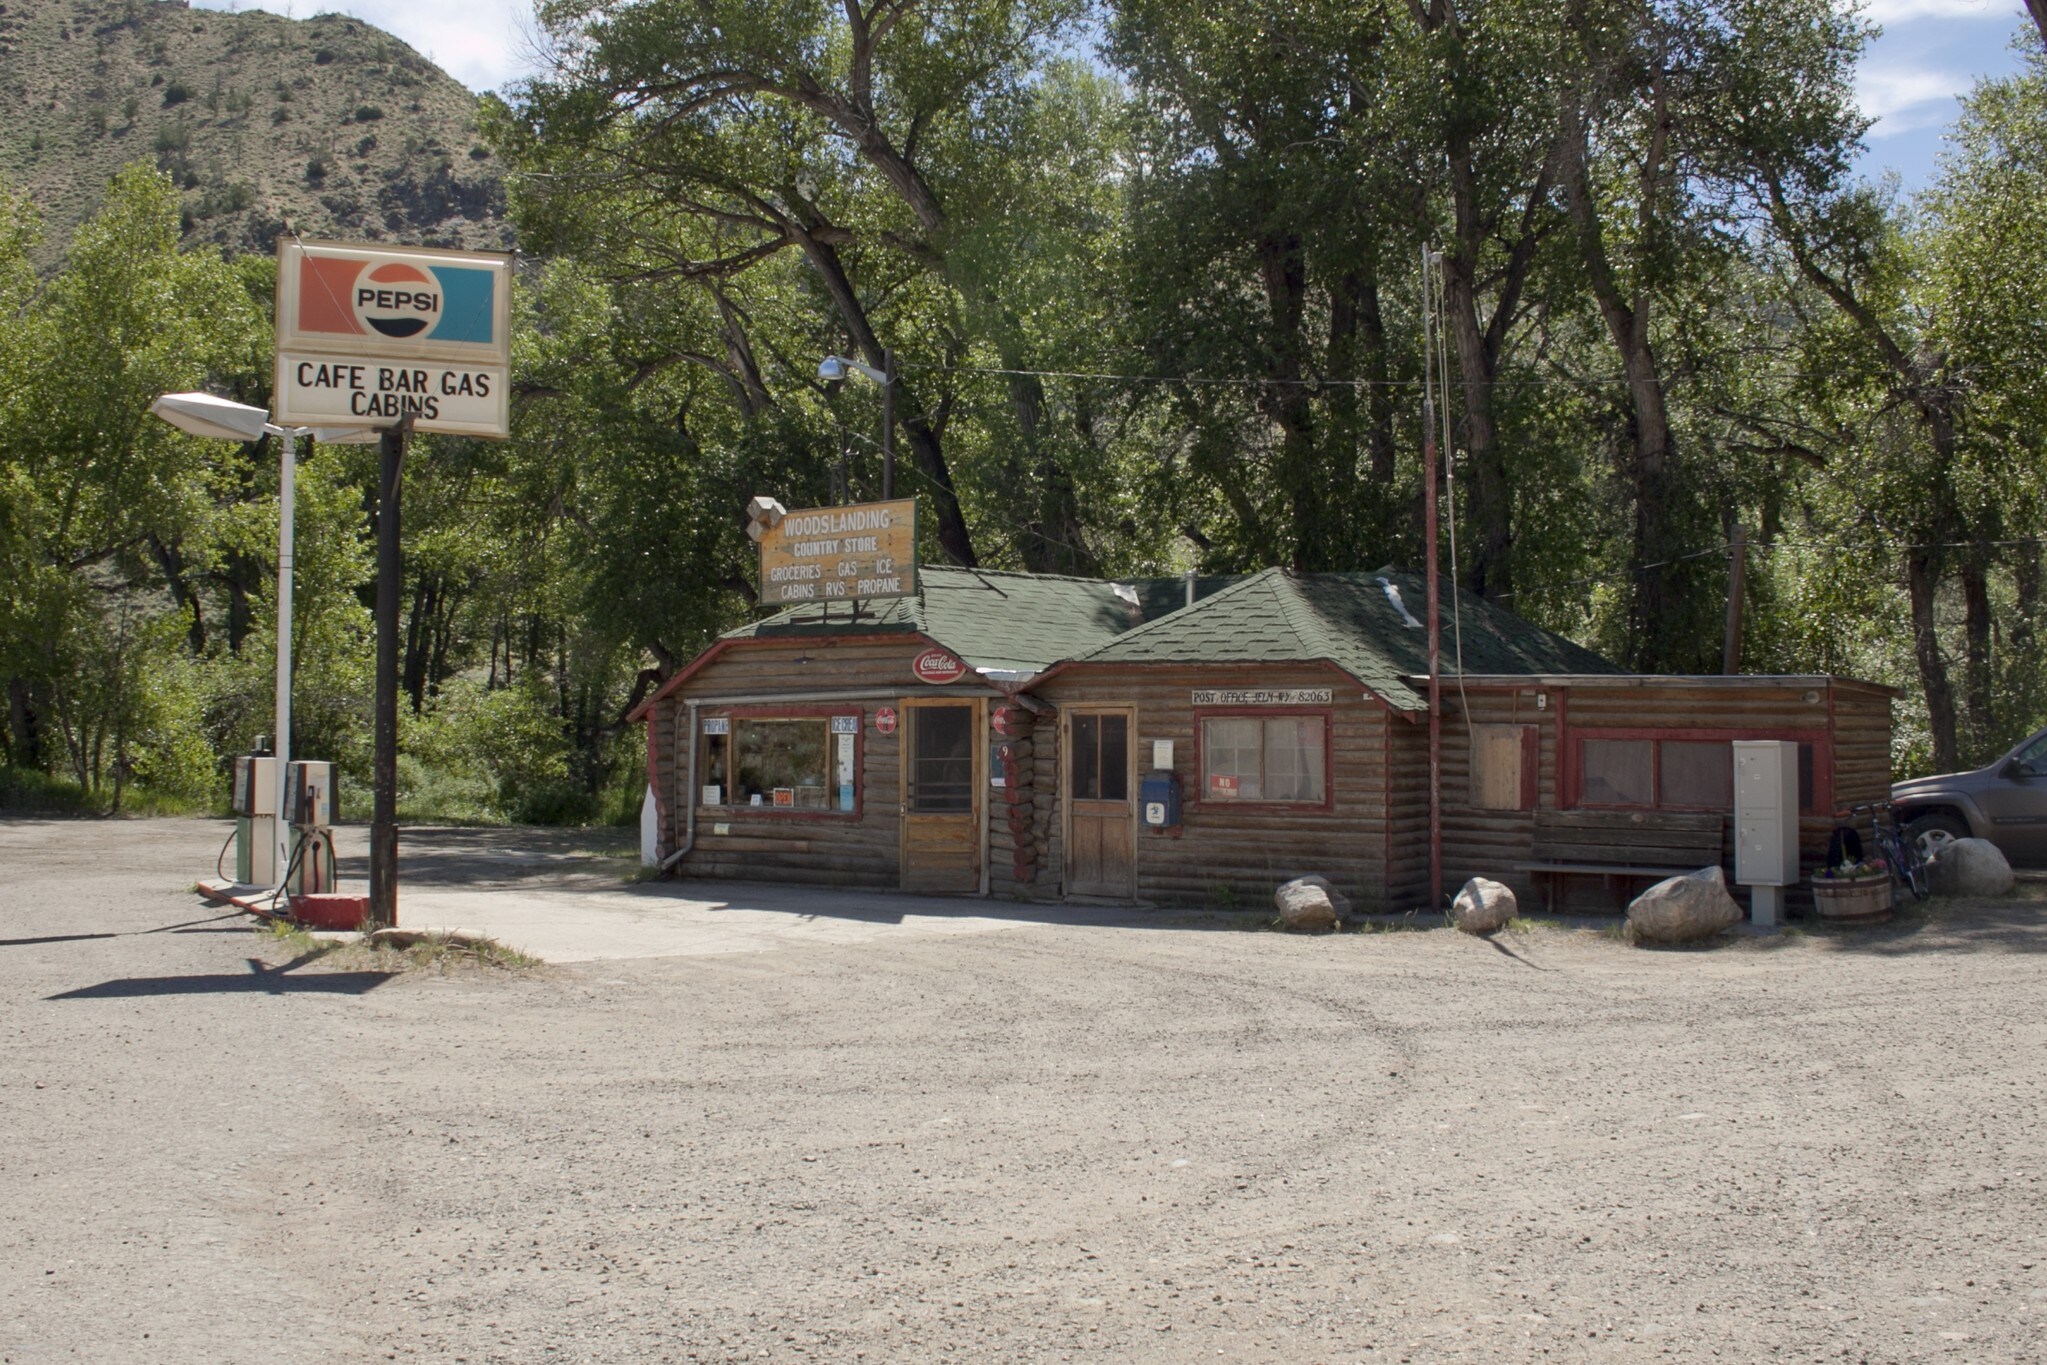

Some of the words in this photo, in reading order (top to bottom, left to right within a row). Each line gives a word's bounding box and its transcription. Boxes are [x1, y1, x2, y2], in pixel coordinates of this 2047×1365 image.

[358, 288, 438, 312] PEPSI
[297, 361, 365, 390] CAFE
[379, 368, 428, 393] BAR
[441, 371, 490, 397] GAS
[351, 391, 439, 420] CABINS
[794, 539, 838, 557] COUNTRY
[845, 537, 877, 552] STORE
[770, 564, 821, 582] GROCERIES
[838, 561, 857, 577] GAS
[876, 558, 892, 574] ICE
[781, 583, 815, 600] CABINS
[826, 581, 845, 596] RVS
[857, 577, 901, 594] PROPANE
[920, 655, 956, 671] Coca-Cola
[1194, 692, 1216, 703] POST
[1298, 691, 1330, 702] 82063
[1219, 777, 1230, 788] NO
